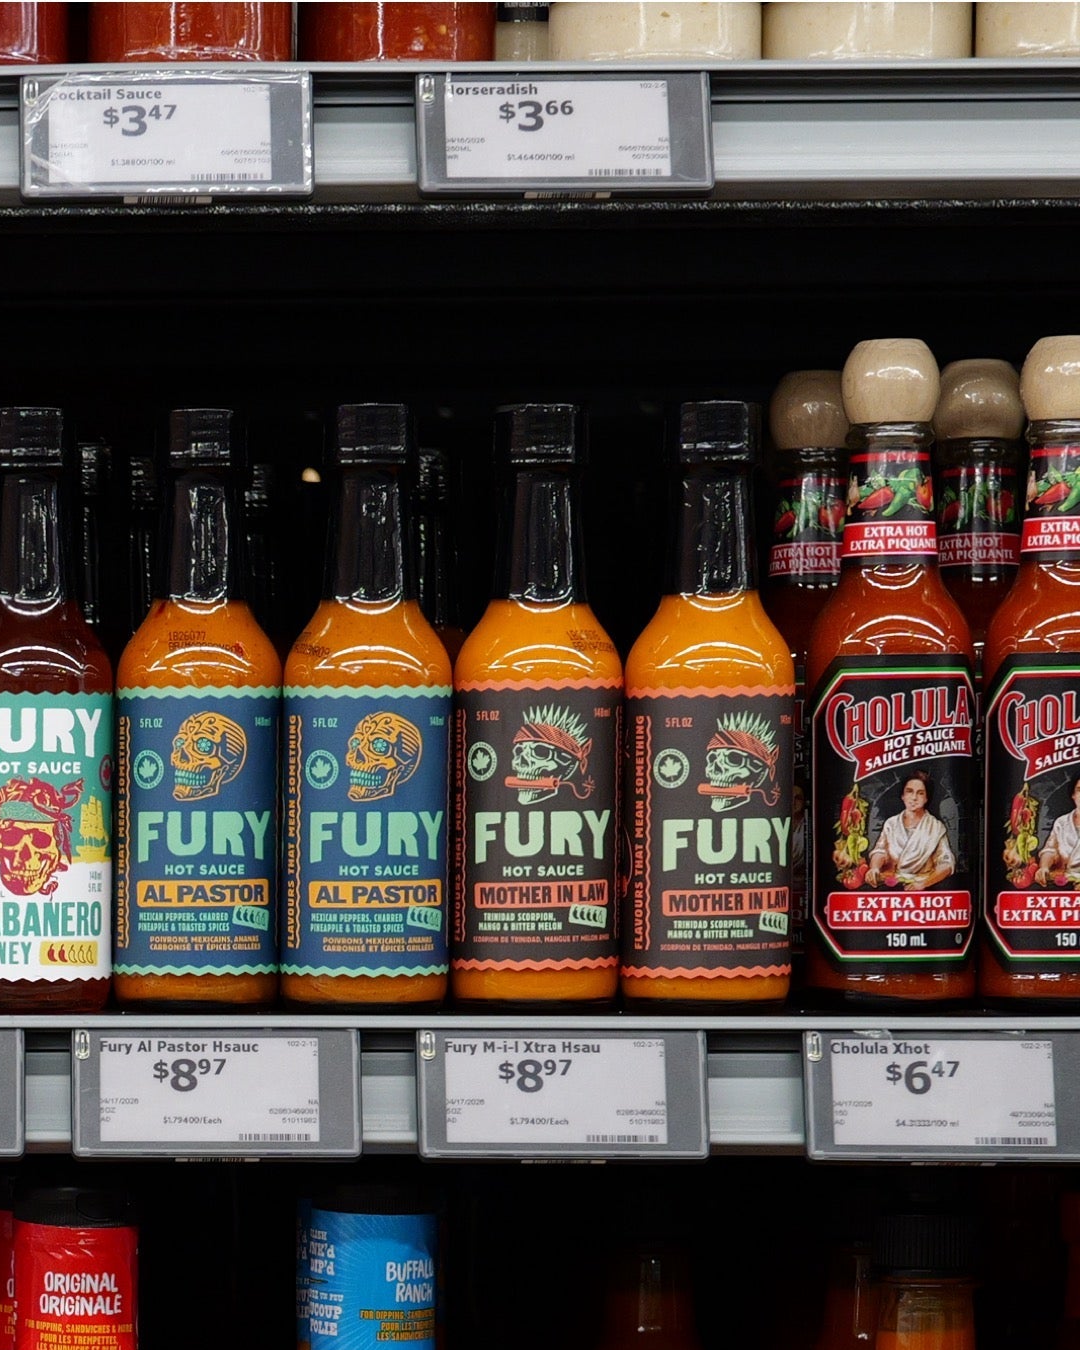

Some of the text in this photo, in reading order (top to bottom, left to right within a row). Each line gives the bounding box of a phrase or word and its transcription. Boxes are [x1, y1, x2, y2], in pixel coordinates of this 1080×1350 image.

[116, 89, 162, 100] Sauce
[864, 524, 928, 538] EXTRA HOT
[826, 686, 970, 762] CHOLULA
[138, 811, 271, 863] FURY
[475, 810, 610, 864] FURY
[164, 864, 245, 875] HOT SAUCE
[502, 865, 584, 877] HOT SAUCE
[143, 884, 265, 903] AL PASTOR
[480, 883, 605, 905] MOTHER IN LAW
[857, 896, 952, 909] EXTRA HOT
[833, 909, 968, 922] EXTRA PIQUANTE
[886, 932, 927, 947] 150 mL
[100, 1040, 259, 1055] Fury Al Pastor Hsauc
[445, 1042, 477, 1055] Fury
[523, 1042, 556, 1053] Xtra
[562, 1042, 600, 1053] Hsau
[831, 1043, 930, 1054] Cholula Xhot
